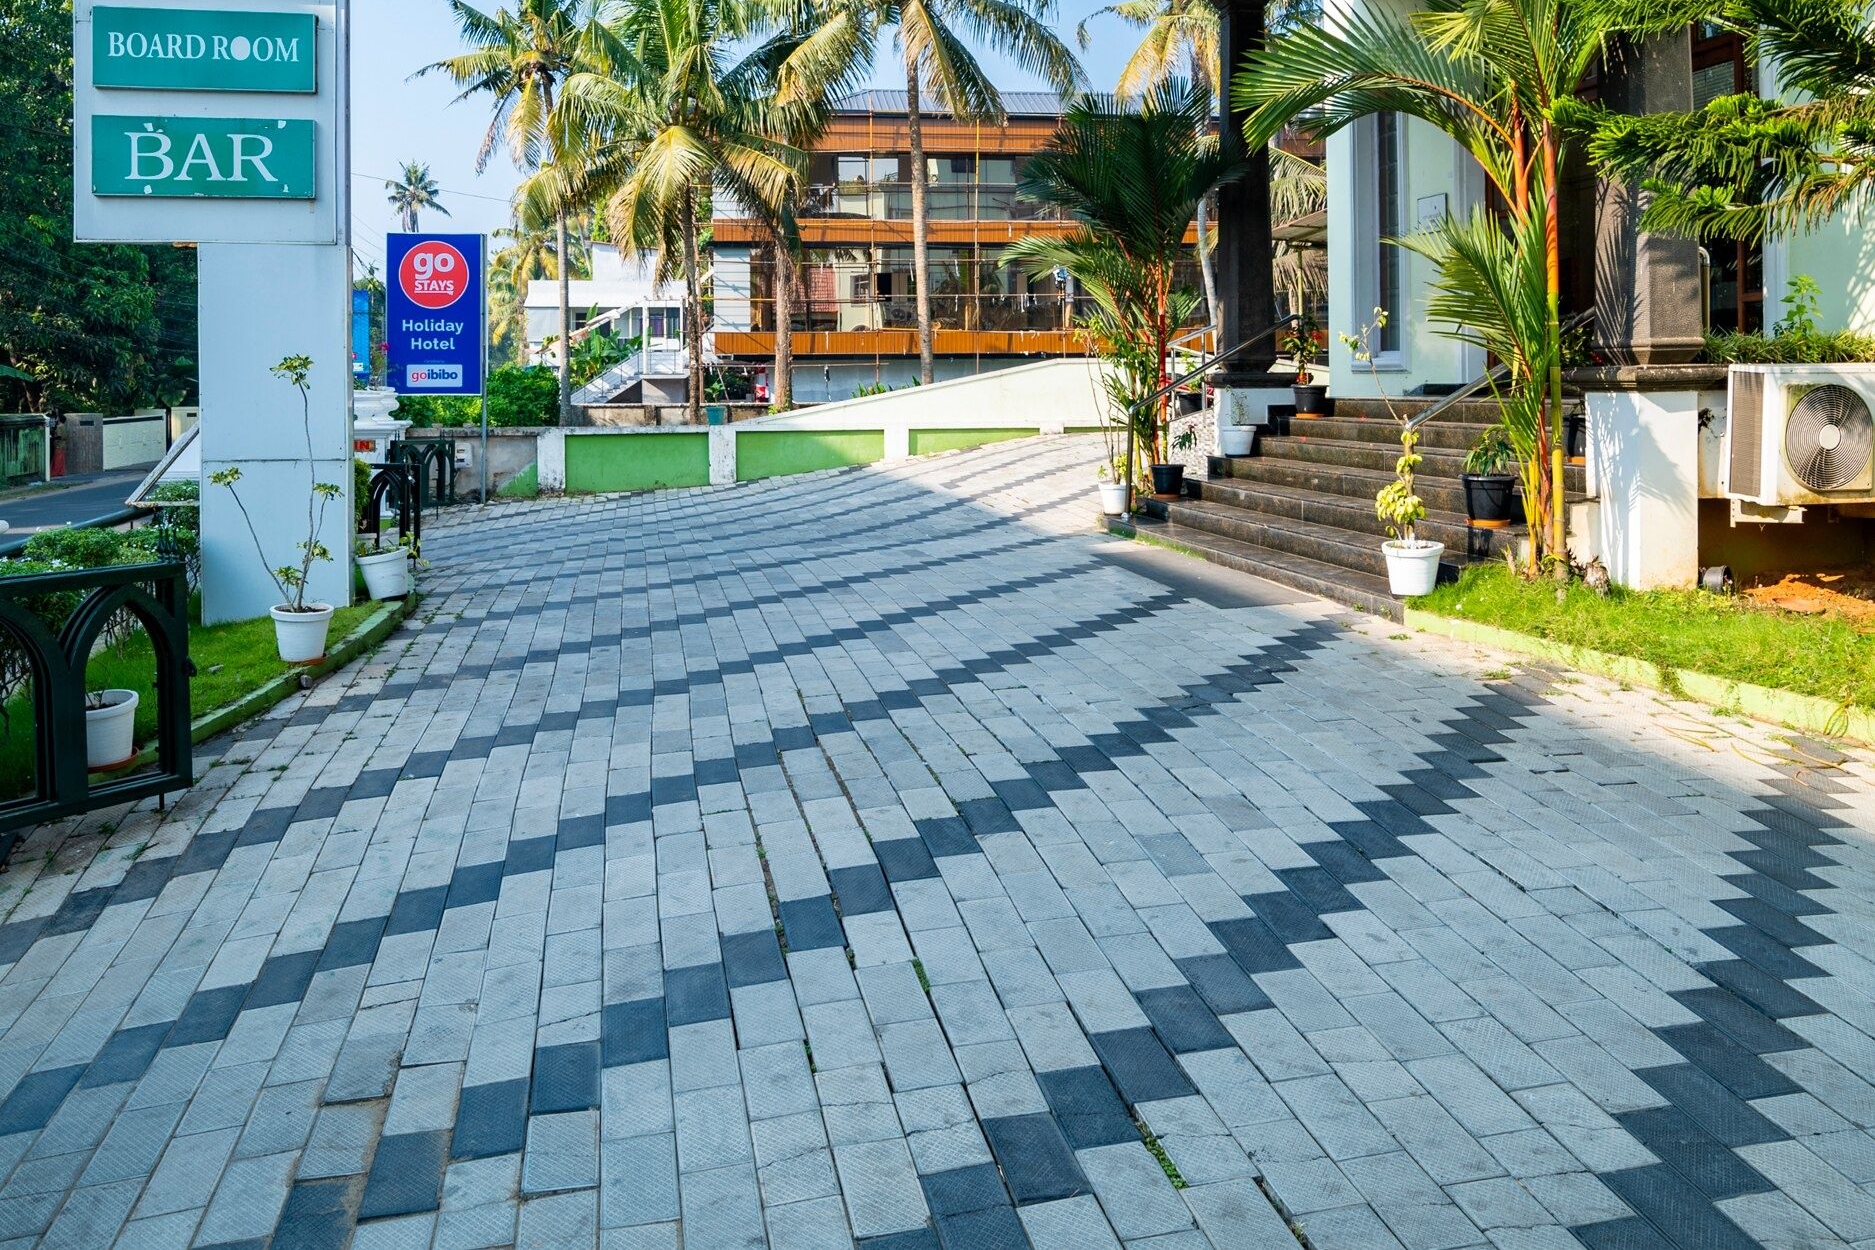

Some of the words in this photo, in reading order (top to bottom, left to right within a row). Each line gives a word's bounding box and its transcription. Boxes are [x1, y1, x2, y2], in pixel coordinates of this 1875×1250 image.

[108, 32, 206, 59] BOARD
[124, 131, 278, 182] BAR
[413, 252, 455, 280] go
[414, 280, 454, 291] STAYS
[402, 319, 464, 334] Holiday
[411, 338, 455, 350] Hotel
[411, 369, 458, 382] goibibo
